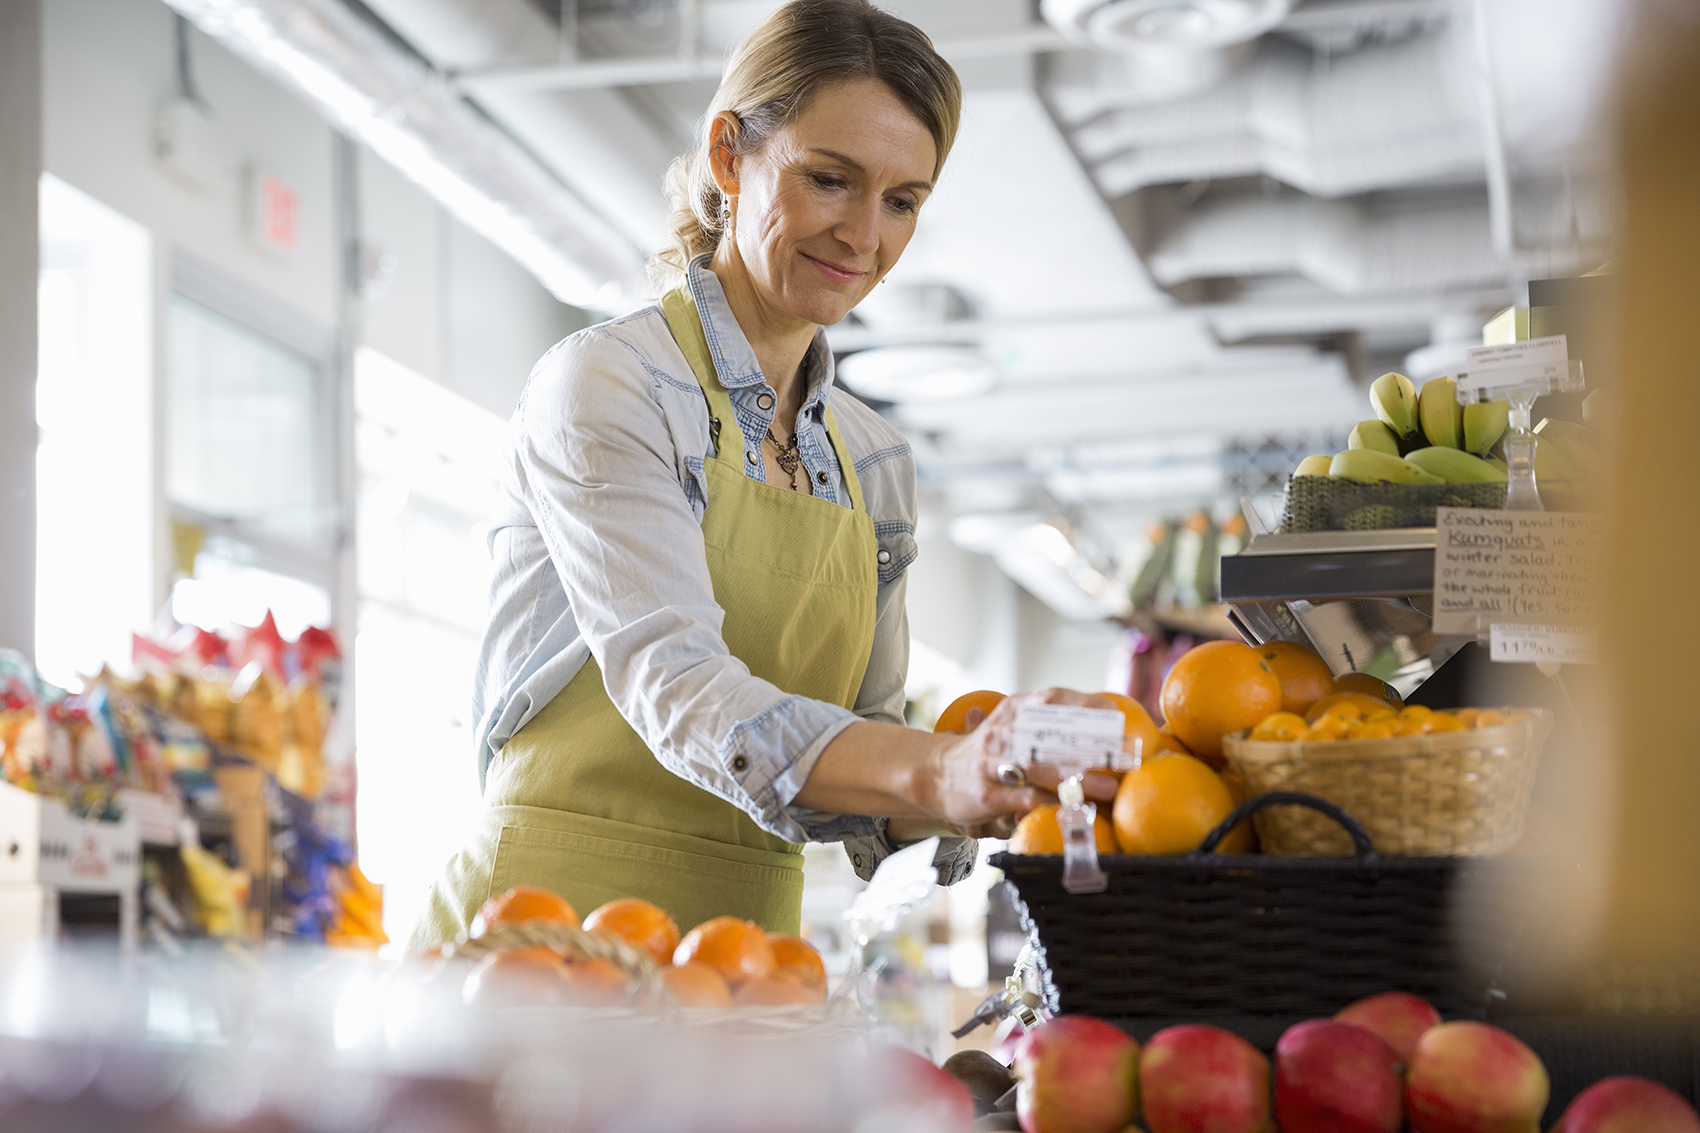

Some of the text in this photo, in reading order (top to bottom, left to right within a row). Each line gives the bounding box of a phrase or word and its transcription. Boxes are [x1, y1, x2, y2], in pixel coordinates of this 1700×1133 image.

[1519, 516, 1553, 529] and
[1448, 529, 1545, 551] Kumquats
[1445, 551, 1502, 563] winter
[1442, 569, 1460, 578] or
[1466, 569, 1548, 588] marinating
[1442, 581, 1467, 593] the
[1471, 583, 1511, 595] whole
[1519, 583, 1560, 597] fruit
[1440, 596, 1473, 608] and
